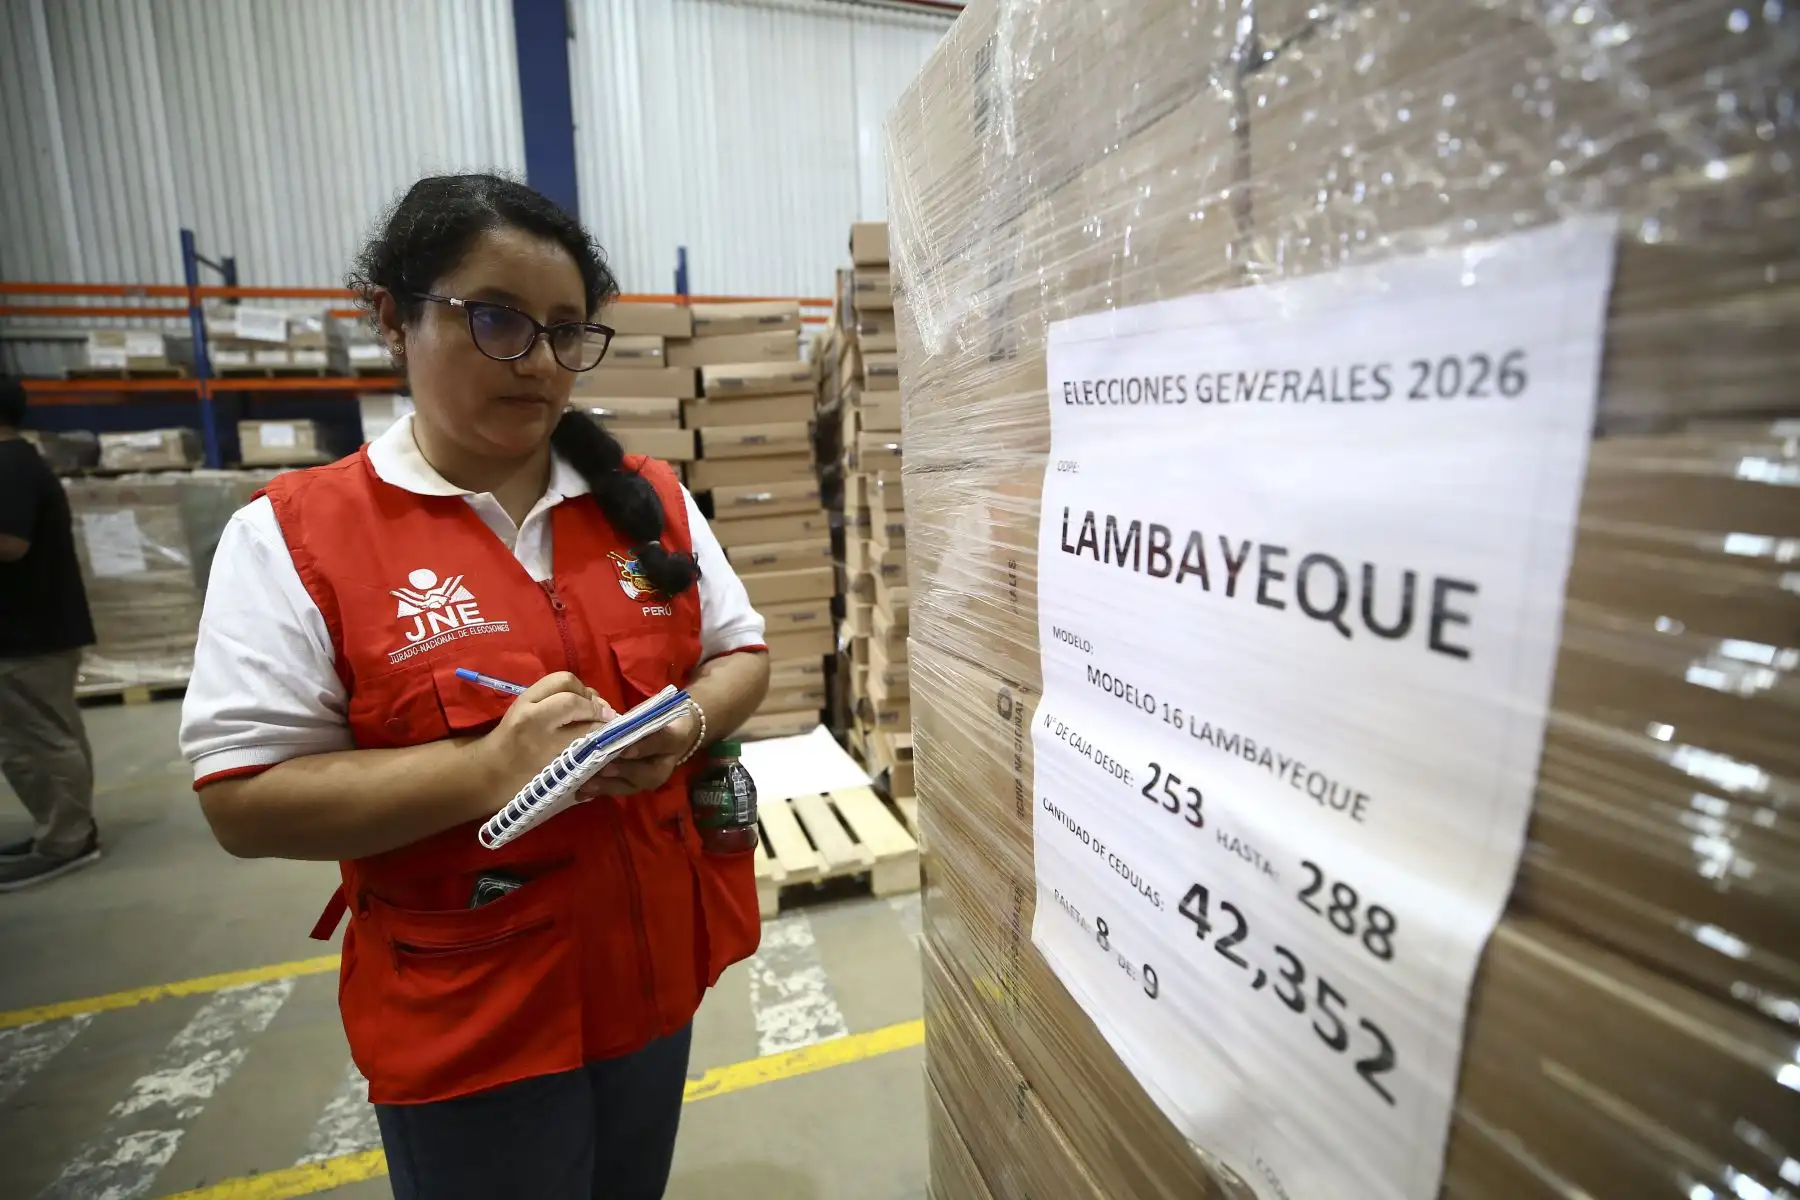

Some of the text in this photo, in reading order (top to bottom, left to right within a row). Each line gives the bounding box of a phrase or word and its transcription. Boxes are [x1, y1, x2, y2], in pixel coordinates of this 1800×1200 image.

[1062, 349, 1530, 406] ELECCIONES GENERALES 2026
[405, 602, 485, 642] JNE
[1060, 505, 1480, 661] LAMBAYEQUE
[390, 624, 510, 665] JURADO NACIONAL DE ELECCIONES
[1052, 626, 1094, 655] MODELO:
[1087, 664, 1371, 824] MODELO 16 LAMBAYEQUE
[1055, 722, 1070, 740] DE
[1069, 732, 1092, 759] CAJA
[1094, 749, 1134, 787] DESDE:
[1141, 762, 1204, 829] 253
[1297, 859, 1397, 962] 288
[1042, 798, 1398, 1107] CANTIDAD DE CEDULAS: 42,352
[1096, 916, 1110, 952] 8
[1117, 952, 1137, 981] DE:
[1143, 963, 1159, 1000] 9
